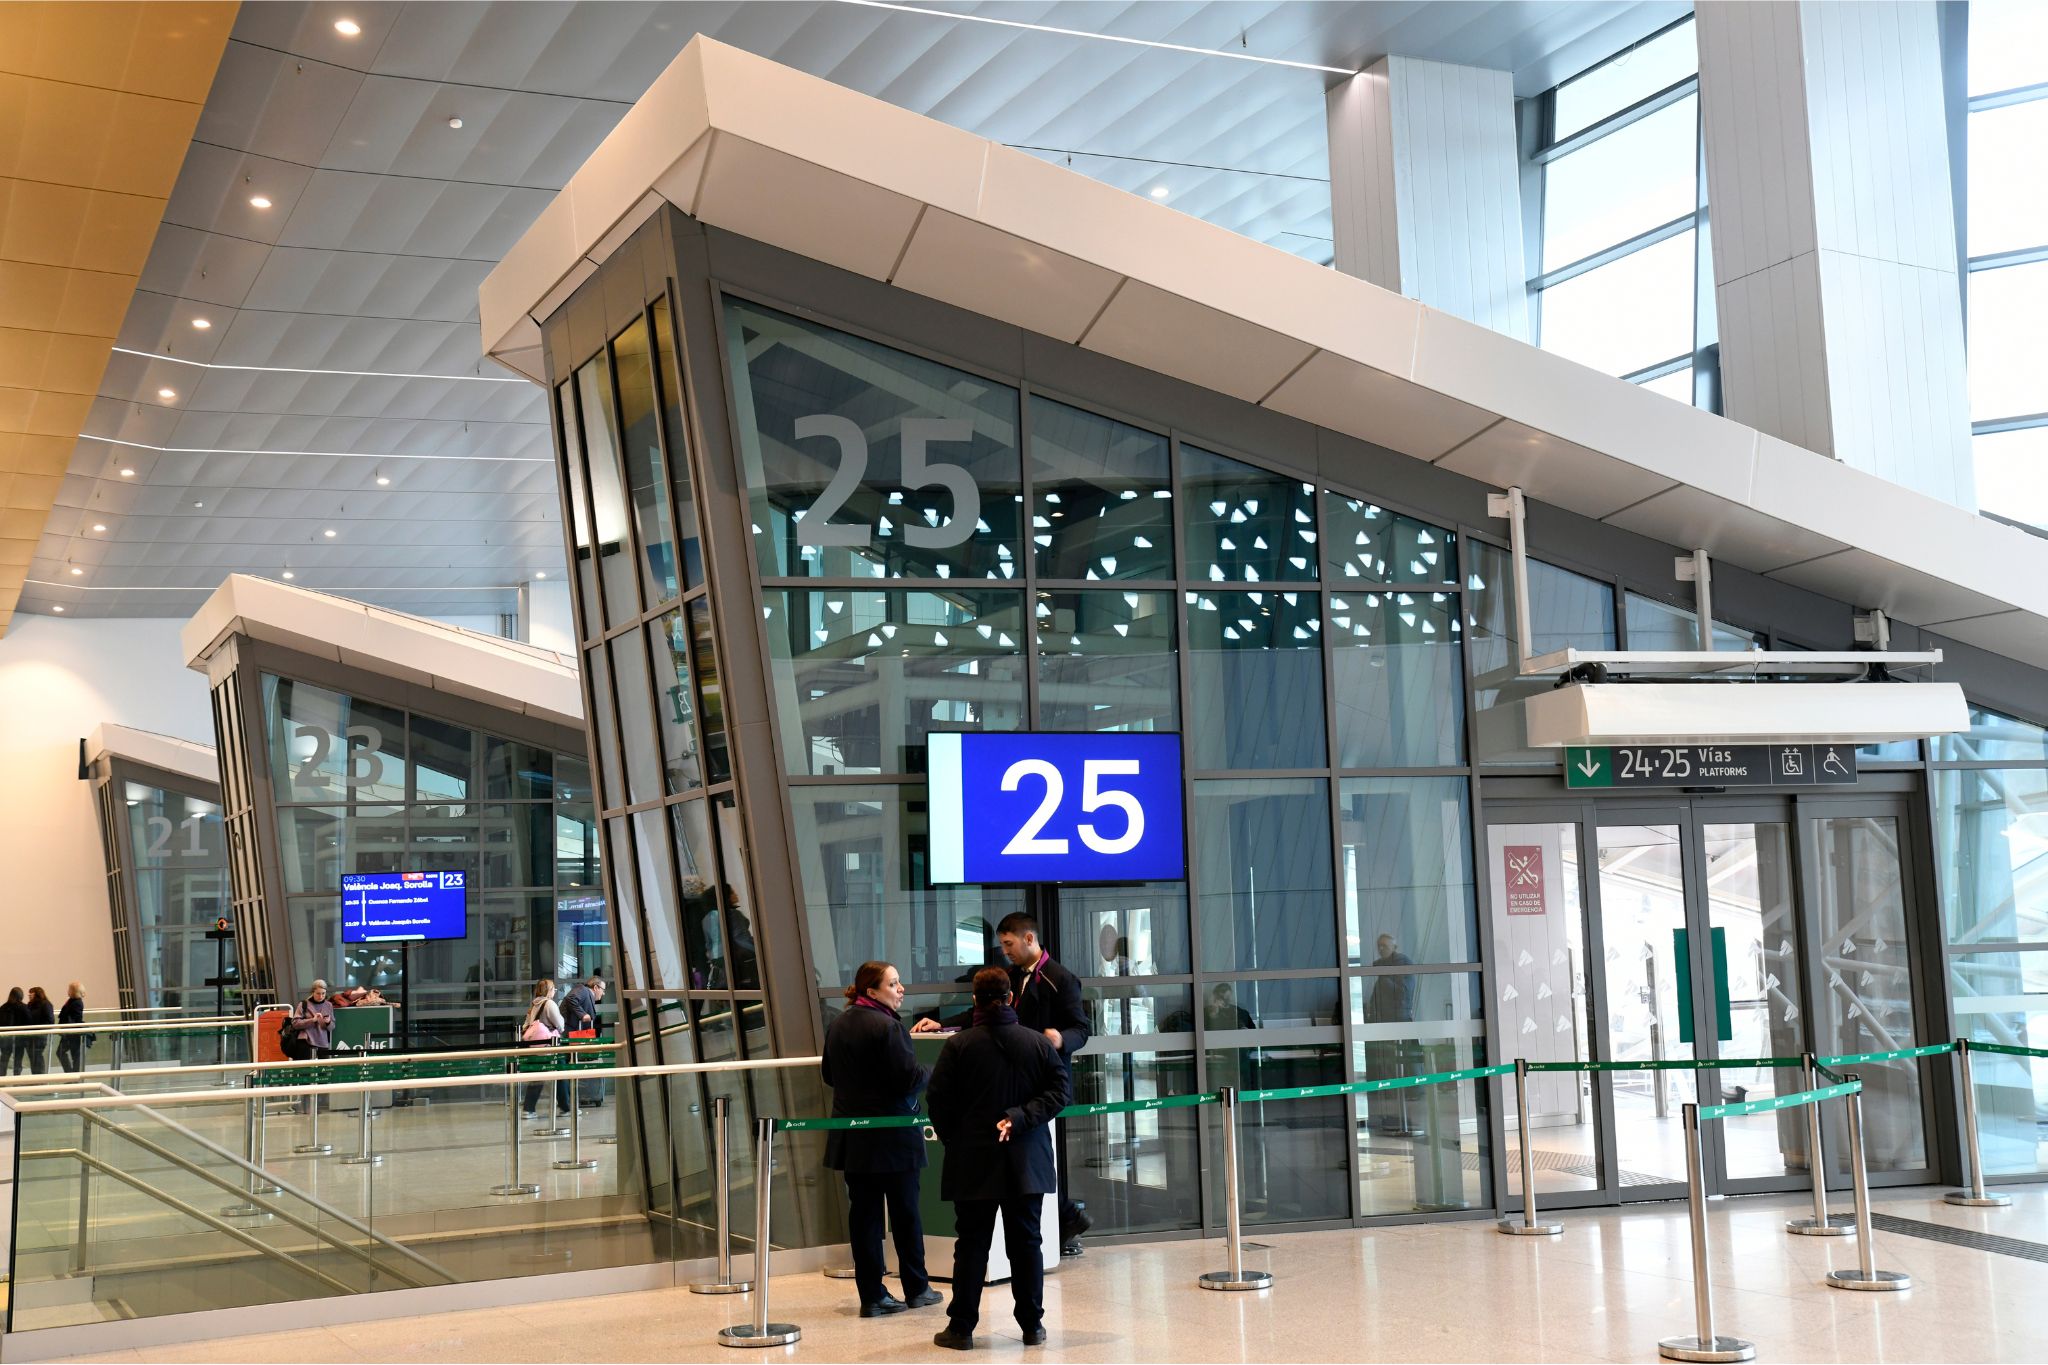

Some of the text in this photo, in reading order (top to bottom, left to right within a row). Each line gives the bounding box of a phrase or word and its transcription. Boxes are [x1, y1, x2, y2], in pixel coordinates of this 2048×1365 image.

[794, 414, 980, 549] 25
[295, 725, 383, 787] 23
[1698, 747, 1732, 762] Vías
[1699, 766, 1747, 777] PLATFORMS
[1000, 759, 1145, 855] 25
[148, 816, 209, 857] 21
[404, 881, 433, 889] Sorolla
[444, 874, 464, 887] 23
